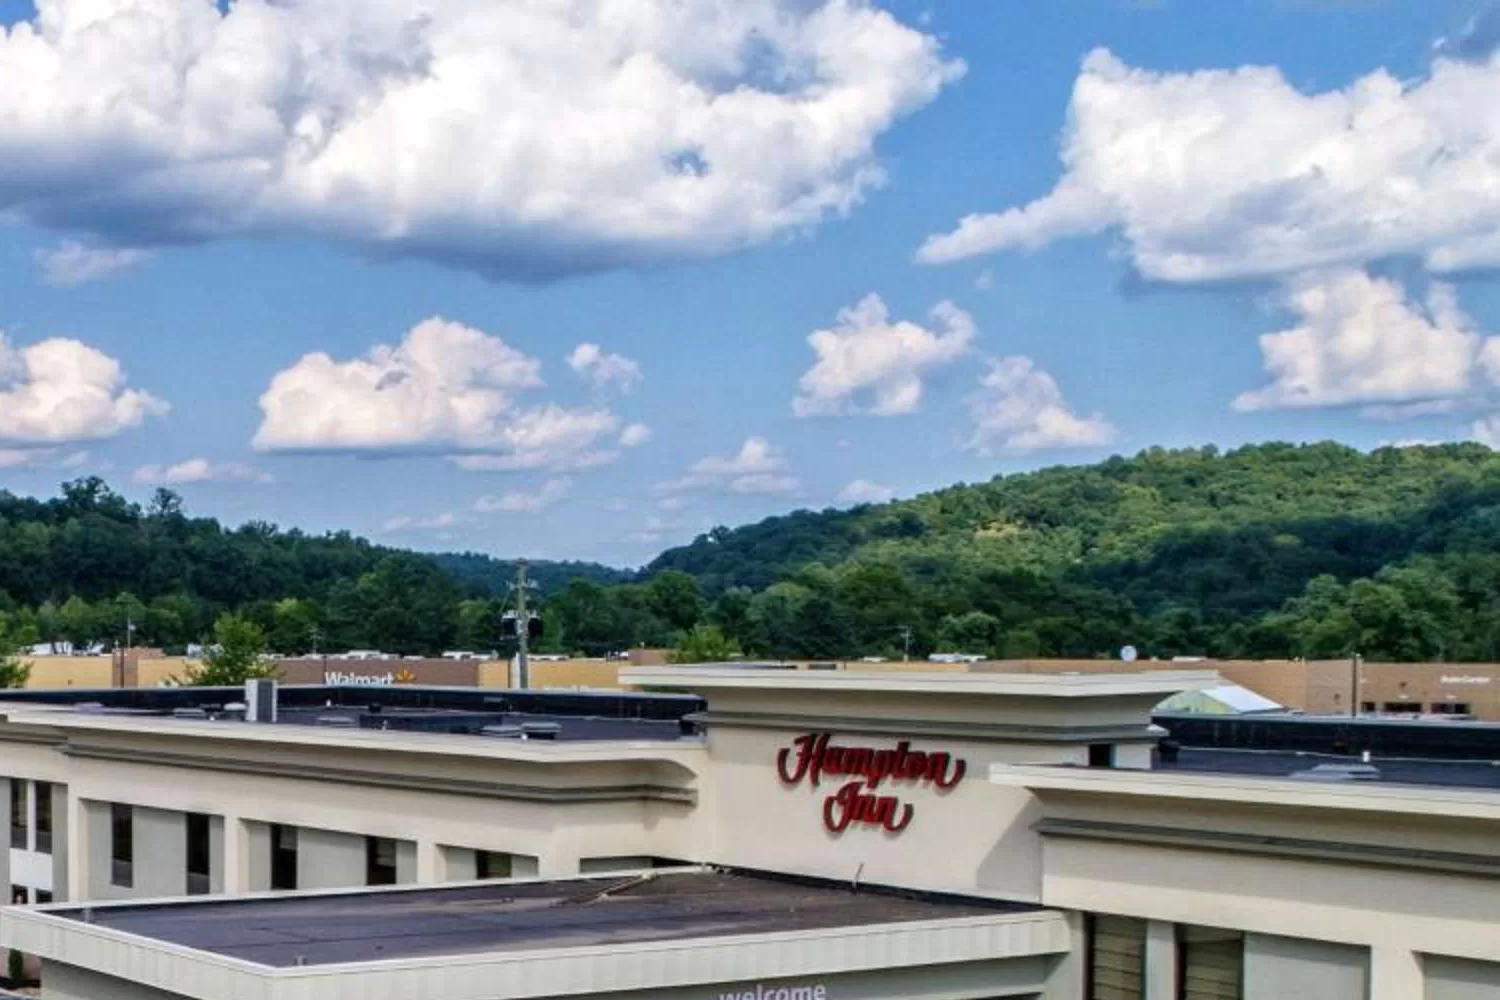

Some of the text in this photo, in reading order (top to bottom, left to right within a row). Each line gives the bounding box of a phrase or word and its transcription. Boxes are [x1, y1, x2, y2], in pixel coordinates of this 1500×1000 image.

[324, 671, 394, 686] Walmart
[777, 732, 967, 789] Hampton
[823, 780, 915, 833] Inn
